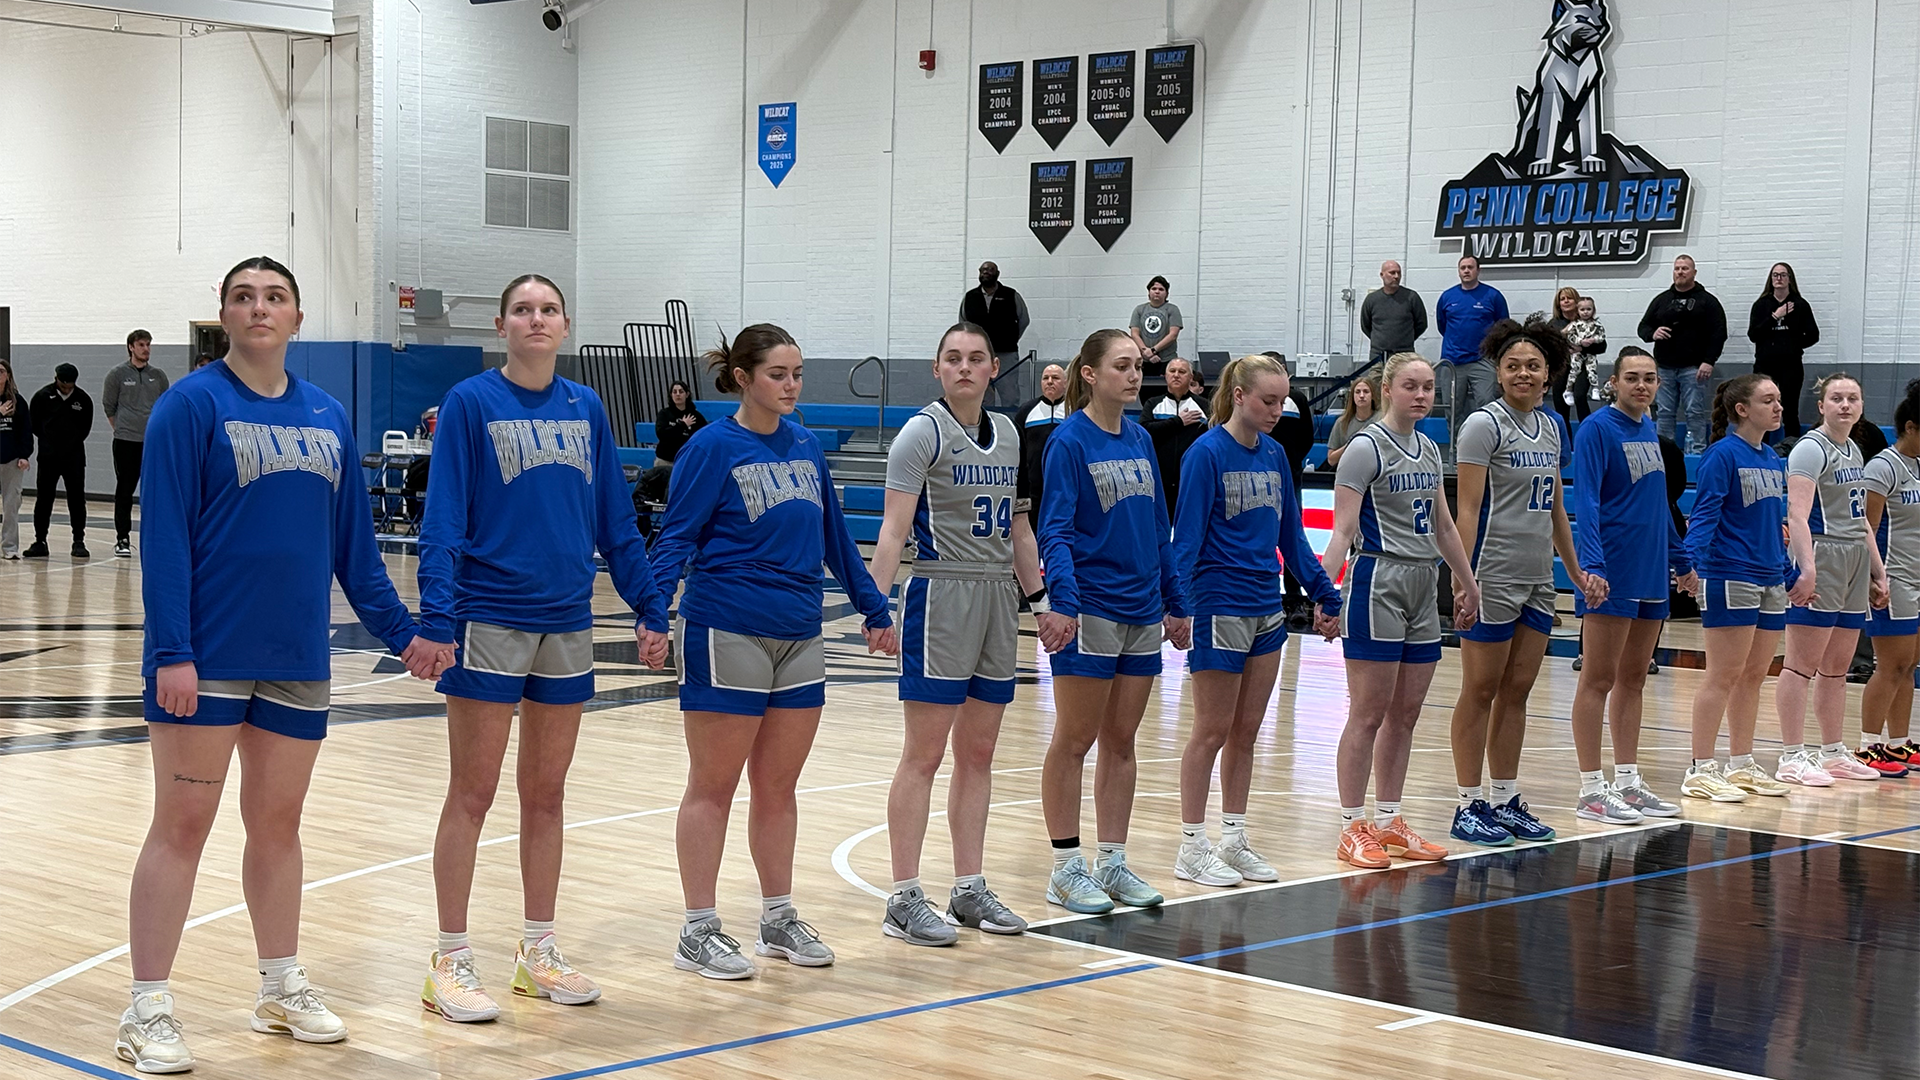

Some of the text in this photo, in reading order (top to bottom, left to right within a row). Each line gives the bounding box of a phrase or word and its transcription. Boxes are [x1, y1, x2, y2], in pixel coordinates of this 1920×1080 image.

[1096, 55, 1128, 68] WILDCAT
[1153, 50, 1187, 64] WILDCAT
[987, 66, 1016, 78] WILDCAT
[1040, 61, 1071, 74] WILDCAT
[1091, 87, 1131, 100] 2005-06
[1157, 83, 1180, 96] 2005
[990, 97, 1011, 109] 2004
[1044, 93, 1065, 105] 2004
[765, 107, 789, 118] WILDCAT
[1094, 112, 1127, 120] CHAMPIONS
[1151, 108, 1185, 116] CHAMPIONS
[985, 120, 1016, 128] CHAMPIONS
[1038, 166, 1069, 177] WILDCAT
[1094, 162, 1125, 174] WILDCAT
[1041, 197, 1063, 208] 2012
[1097, 194, 1119, 205] 2012
[1443, 178, 1681, 228] PENN COLLEGE
[1471, 229, 1639, 259] WILDCATS
[1527, 475, 1555, 512] 12
[970, 494, 1012, 540] 34
